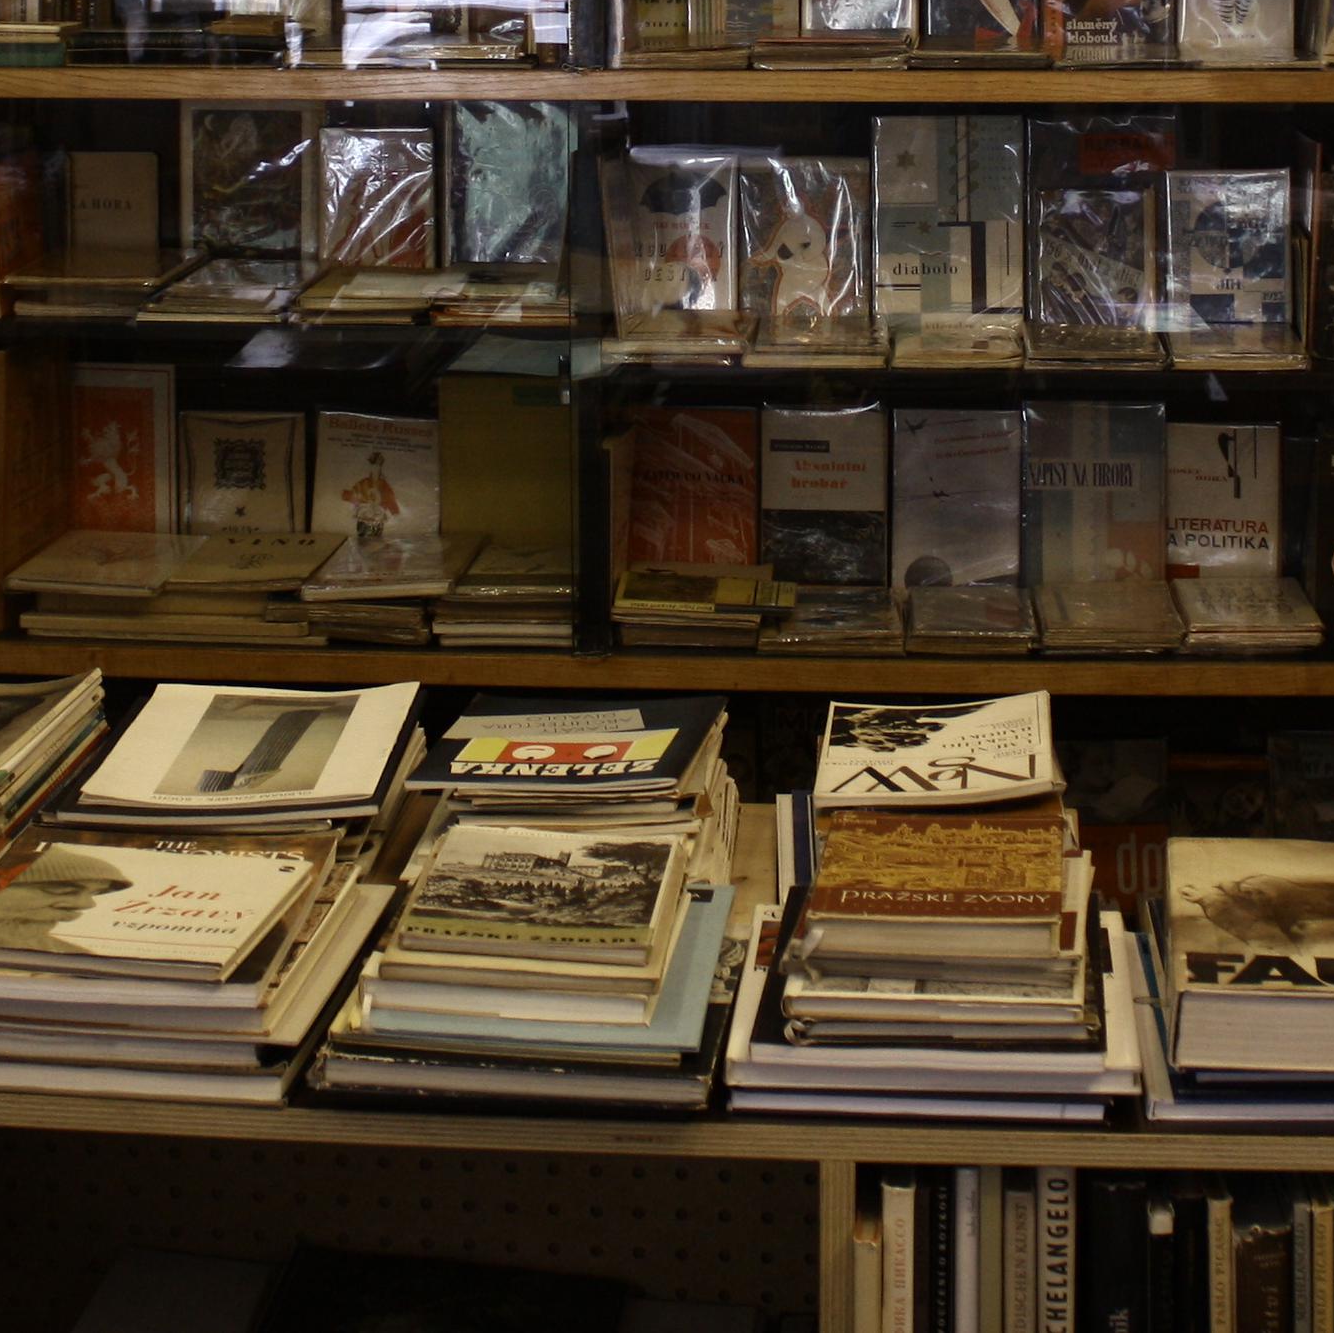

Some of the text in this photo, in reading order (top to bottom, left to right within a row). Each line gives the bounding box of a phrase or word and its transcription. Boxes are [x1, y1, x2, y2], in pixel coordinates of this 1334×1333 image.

[1067, 30, 1119, 45] klobouk
[892, 262, 959, 276] diabolo
[1165, 516, 1270, 535] LITERATURA
[1184, 533, 1270, 551] POLITIKA
[450, 759, 661, 777] ZELENKA
[959, 893, 1051, 904] ZVONY
